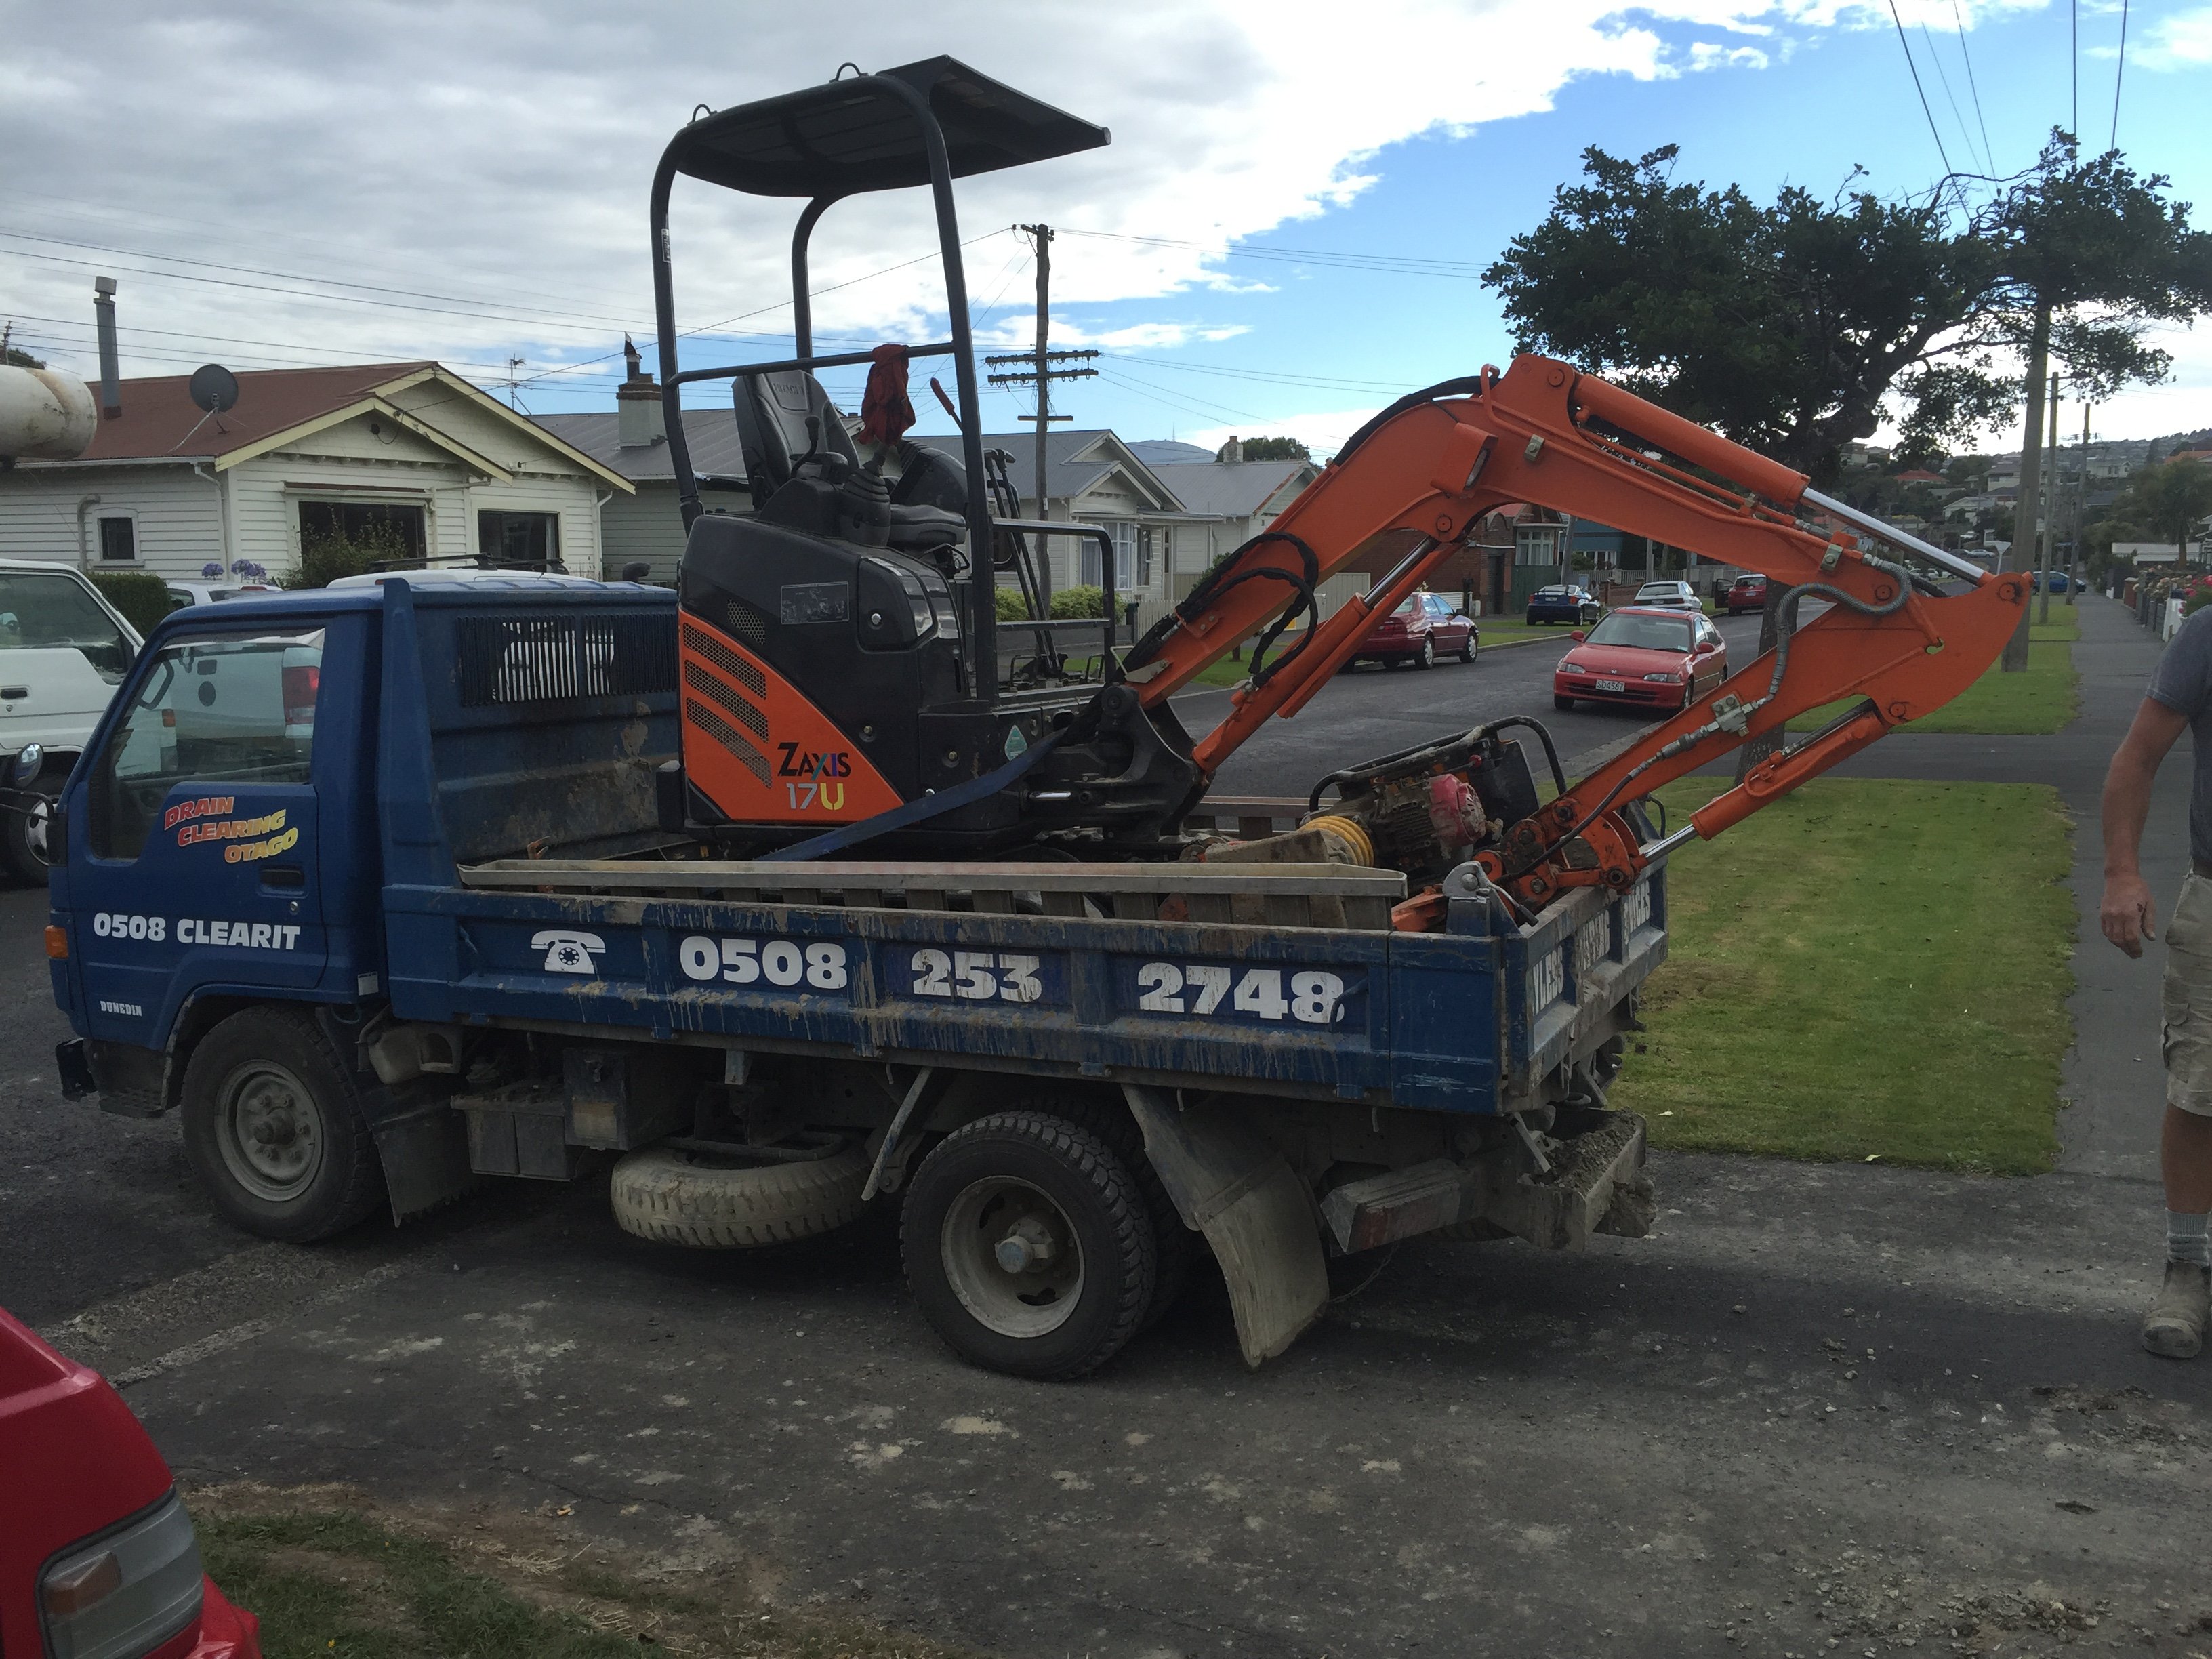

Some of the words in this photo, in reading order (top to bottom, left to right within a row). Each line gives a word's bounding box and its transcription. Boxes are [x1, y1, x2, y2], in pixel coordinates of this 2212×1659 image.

[1597, 680, 1624, 691] SD4567
[777, 742, 851, 781] ZAXIS
[164, 796, 234, 830] DRAIN
[786, 783, 844, 810] 17U
[178, 808, 286, 846] CLEARING
[224, 827, 298, 863] OTAGO
[94, 912, 165, 941] 0508
[177, 919, 300, 950] CLEARIT
[680, 935, 847, 989] 0508
[911, 949, 1042, 1002] 253
[1137, 963, 1345, 1023] 2748
[100, 1000, 142, 1017] DUNEDIN
